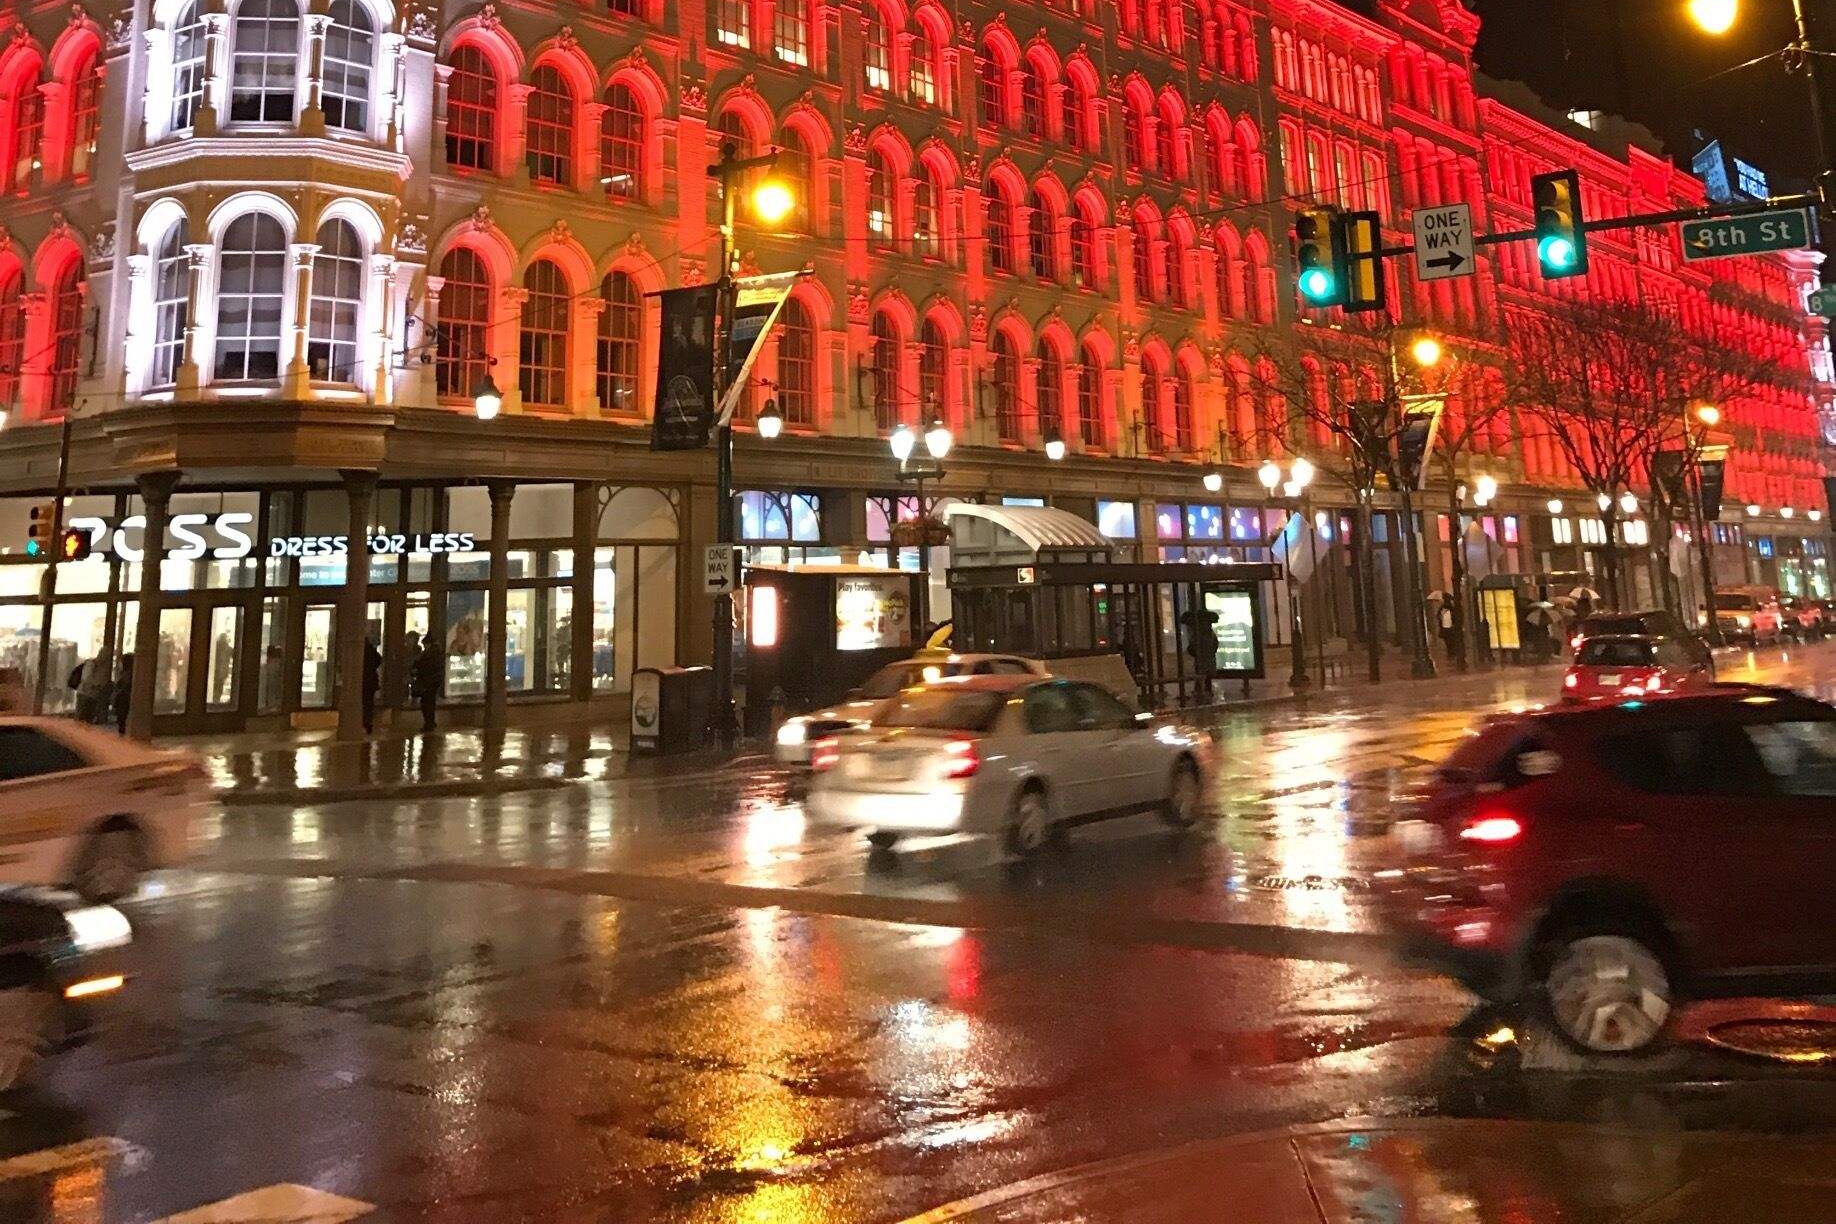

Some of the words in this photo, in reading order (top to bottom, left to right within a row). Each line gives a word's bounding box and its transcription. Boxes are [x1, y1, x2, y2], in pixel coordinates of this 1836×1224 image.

[1424, 210, 1461, 230] ONE
[1424, 229, 1462, 249] WAY
[1698, 225, 1746, 248] 8th
[1759, 220, 1792, 242] St
[271, 536, 348, 557] DRESS
[415, 532, 475, 554] LESS
[708, 548, 728, 561] ONE
[708, 561, 729, 574] WAY
[838, 581, 853, 593] Play
